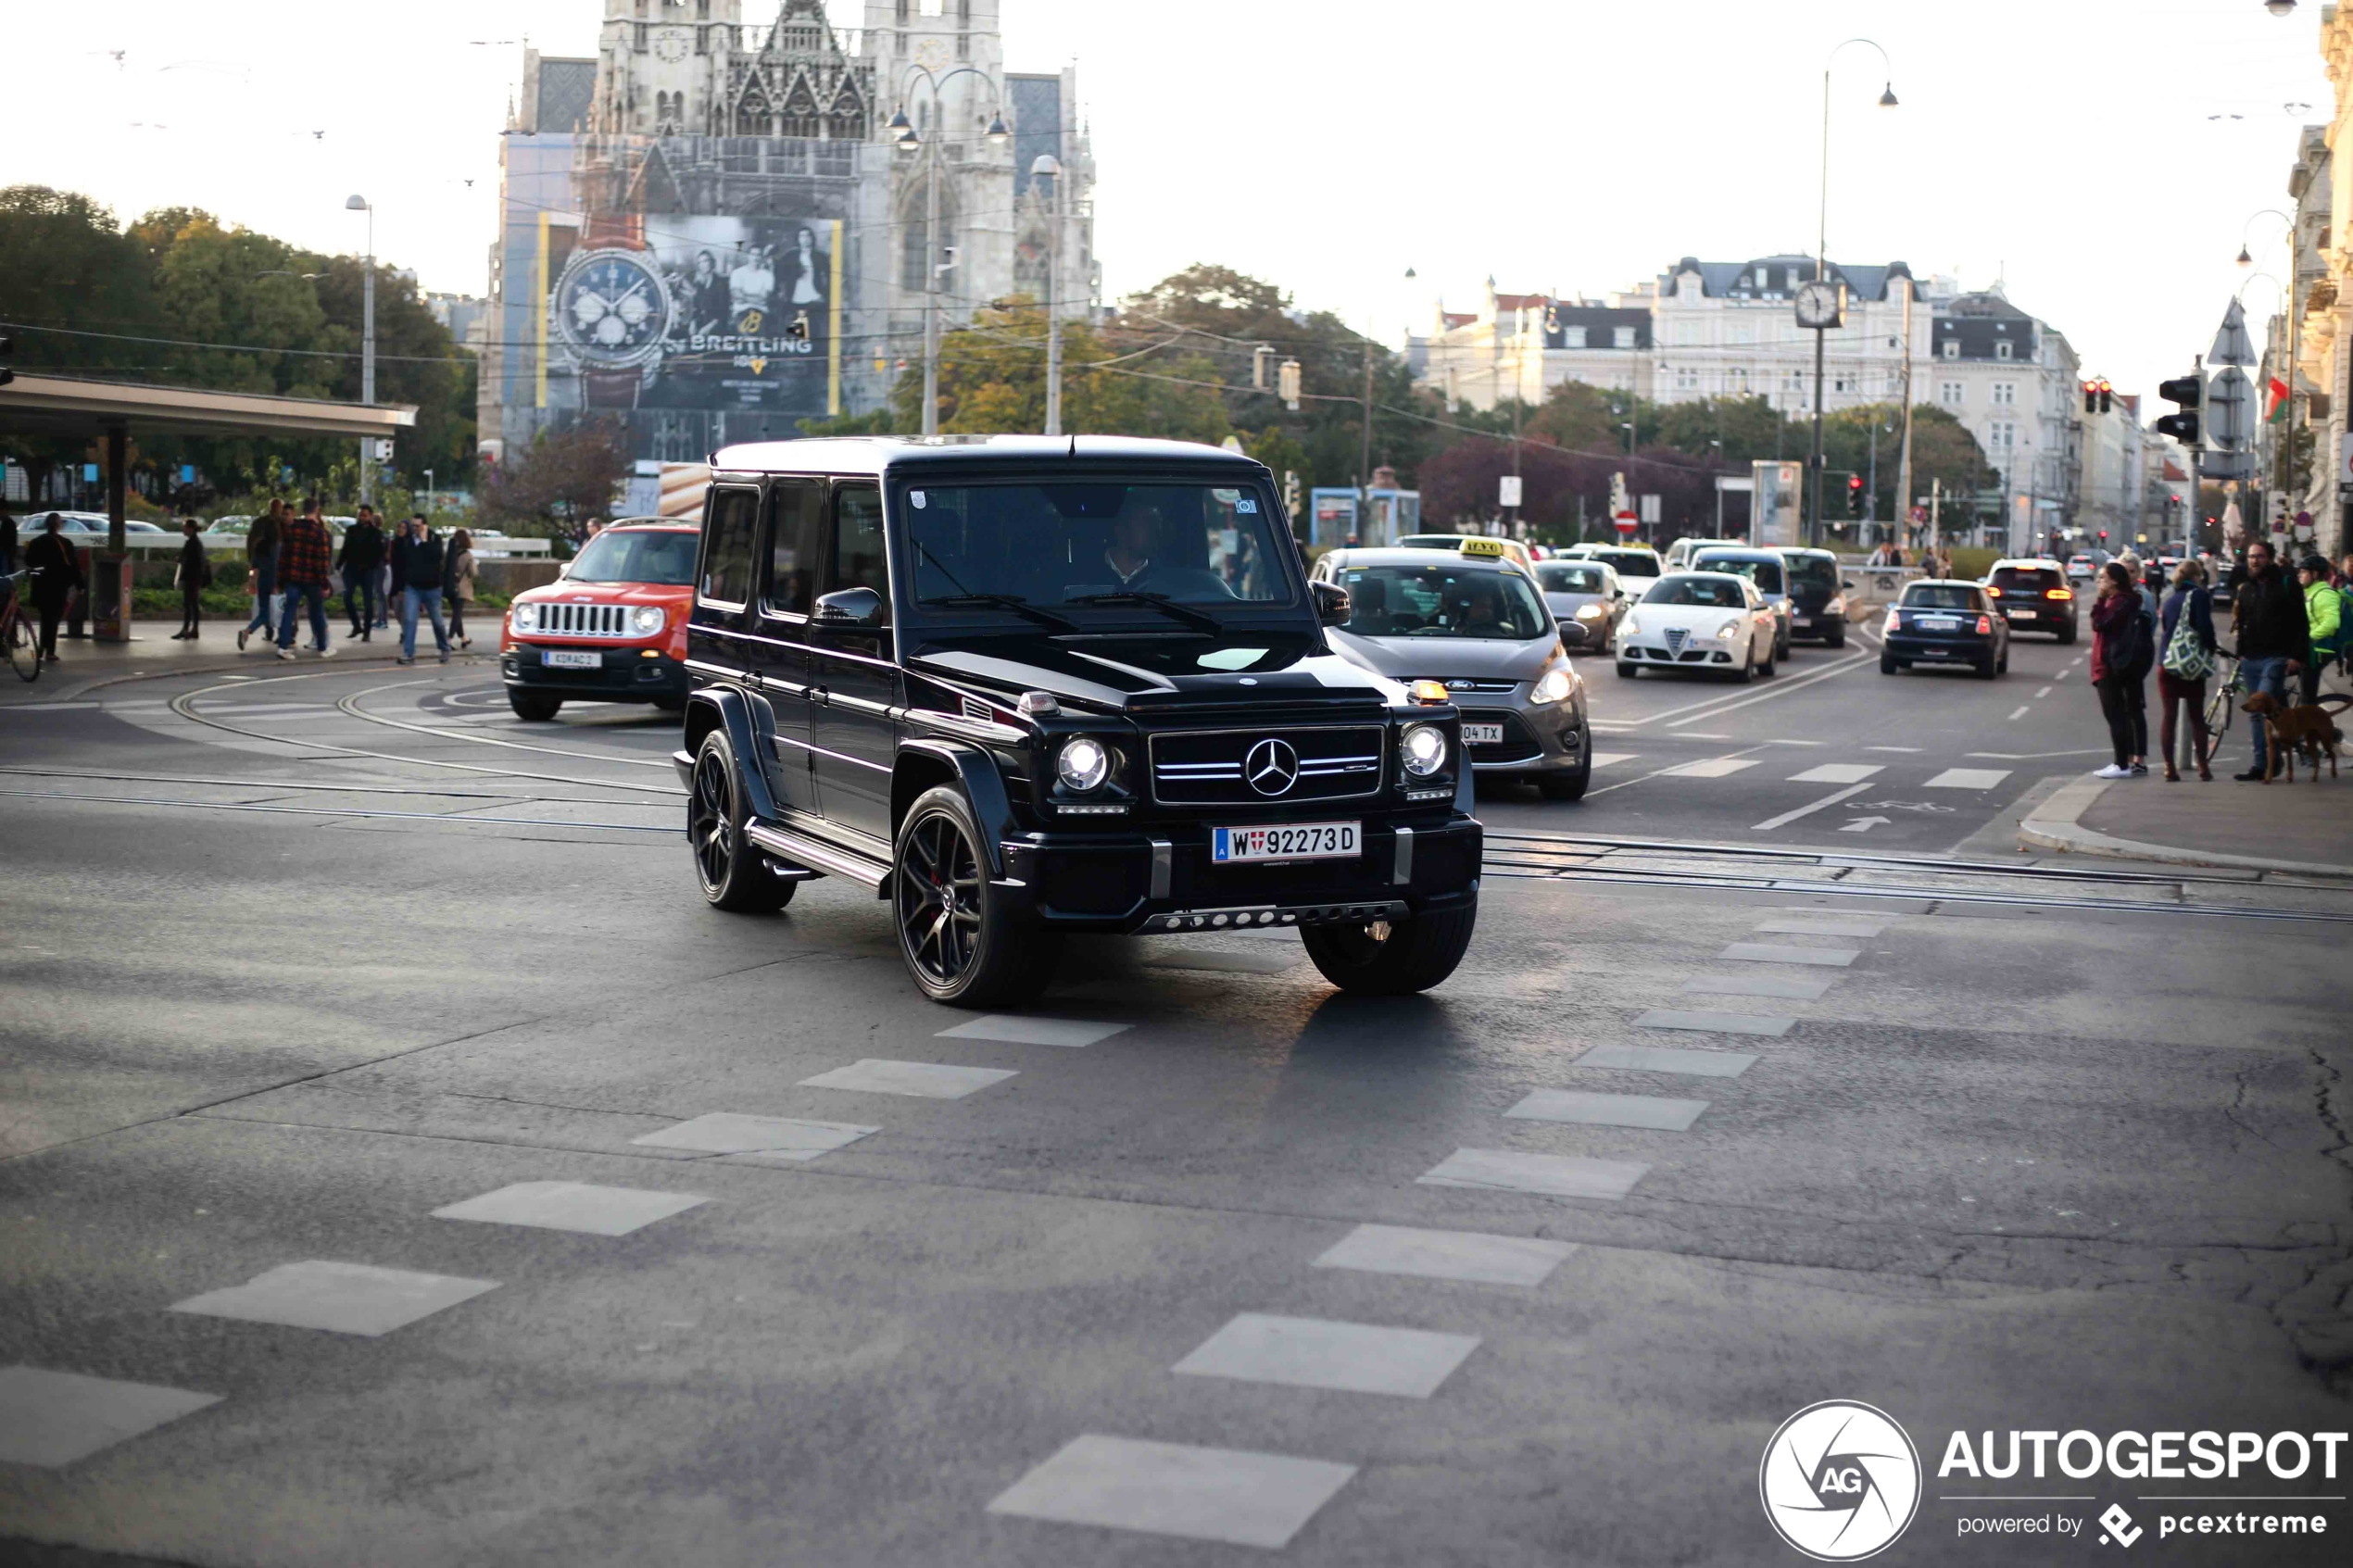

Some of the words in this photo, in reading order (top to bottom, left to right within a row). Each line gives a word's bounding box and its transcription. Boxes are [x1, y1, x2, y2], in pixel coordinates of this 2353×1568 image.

[690, 334, 812, 353] BREITLING
[1467, 544, 1498, 552] TAXI
[1460, 727, 1478, 739] 04
[1482, 728, 1497, 739] TX
[1233, 833, 1248, 856] W
